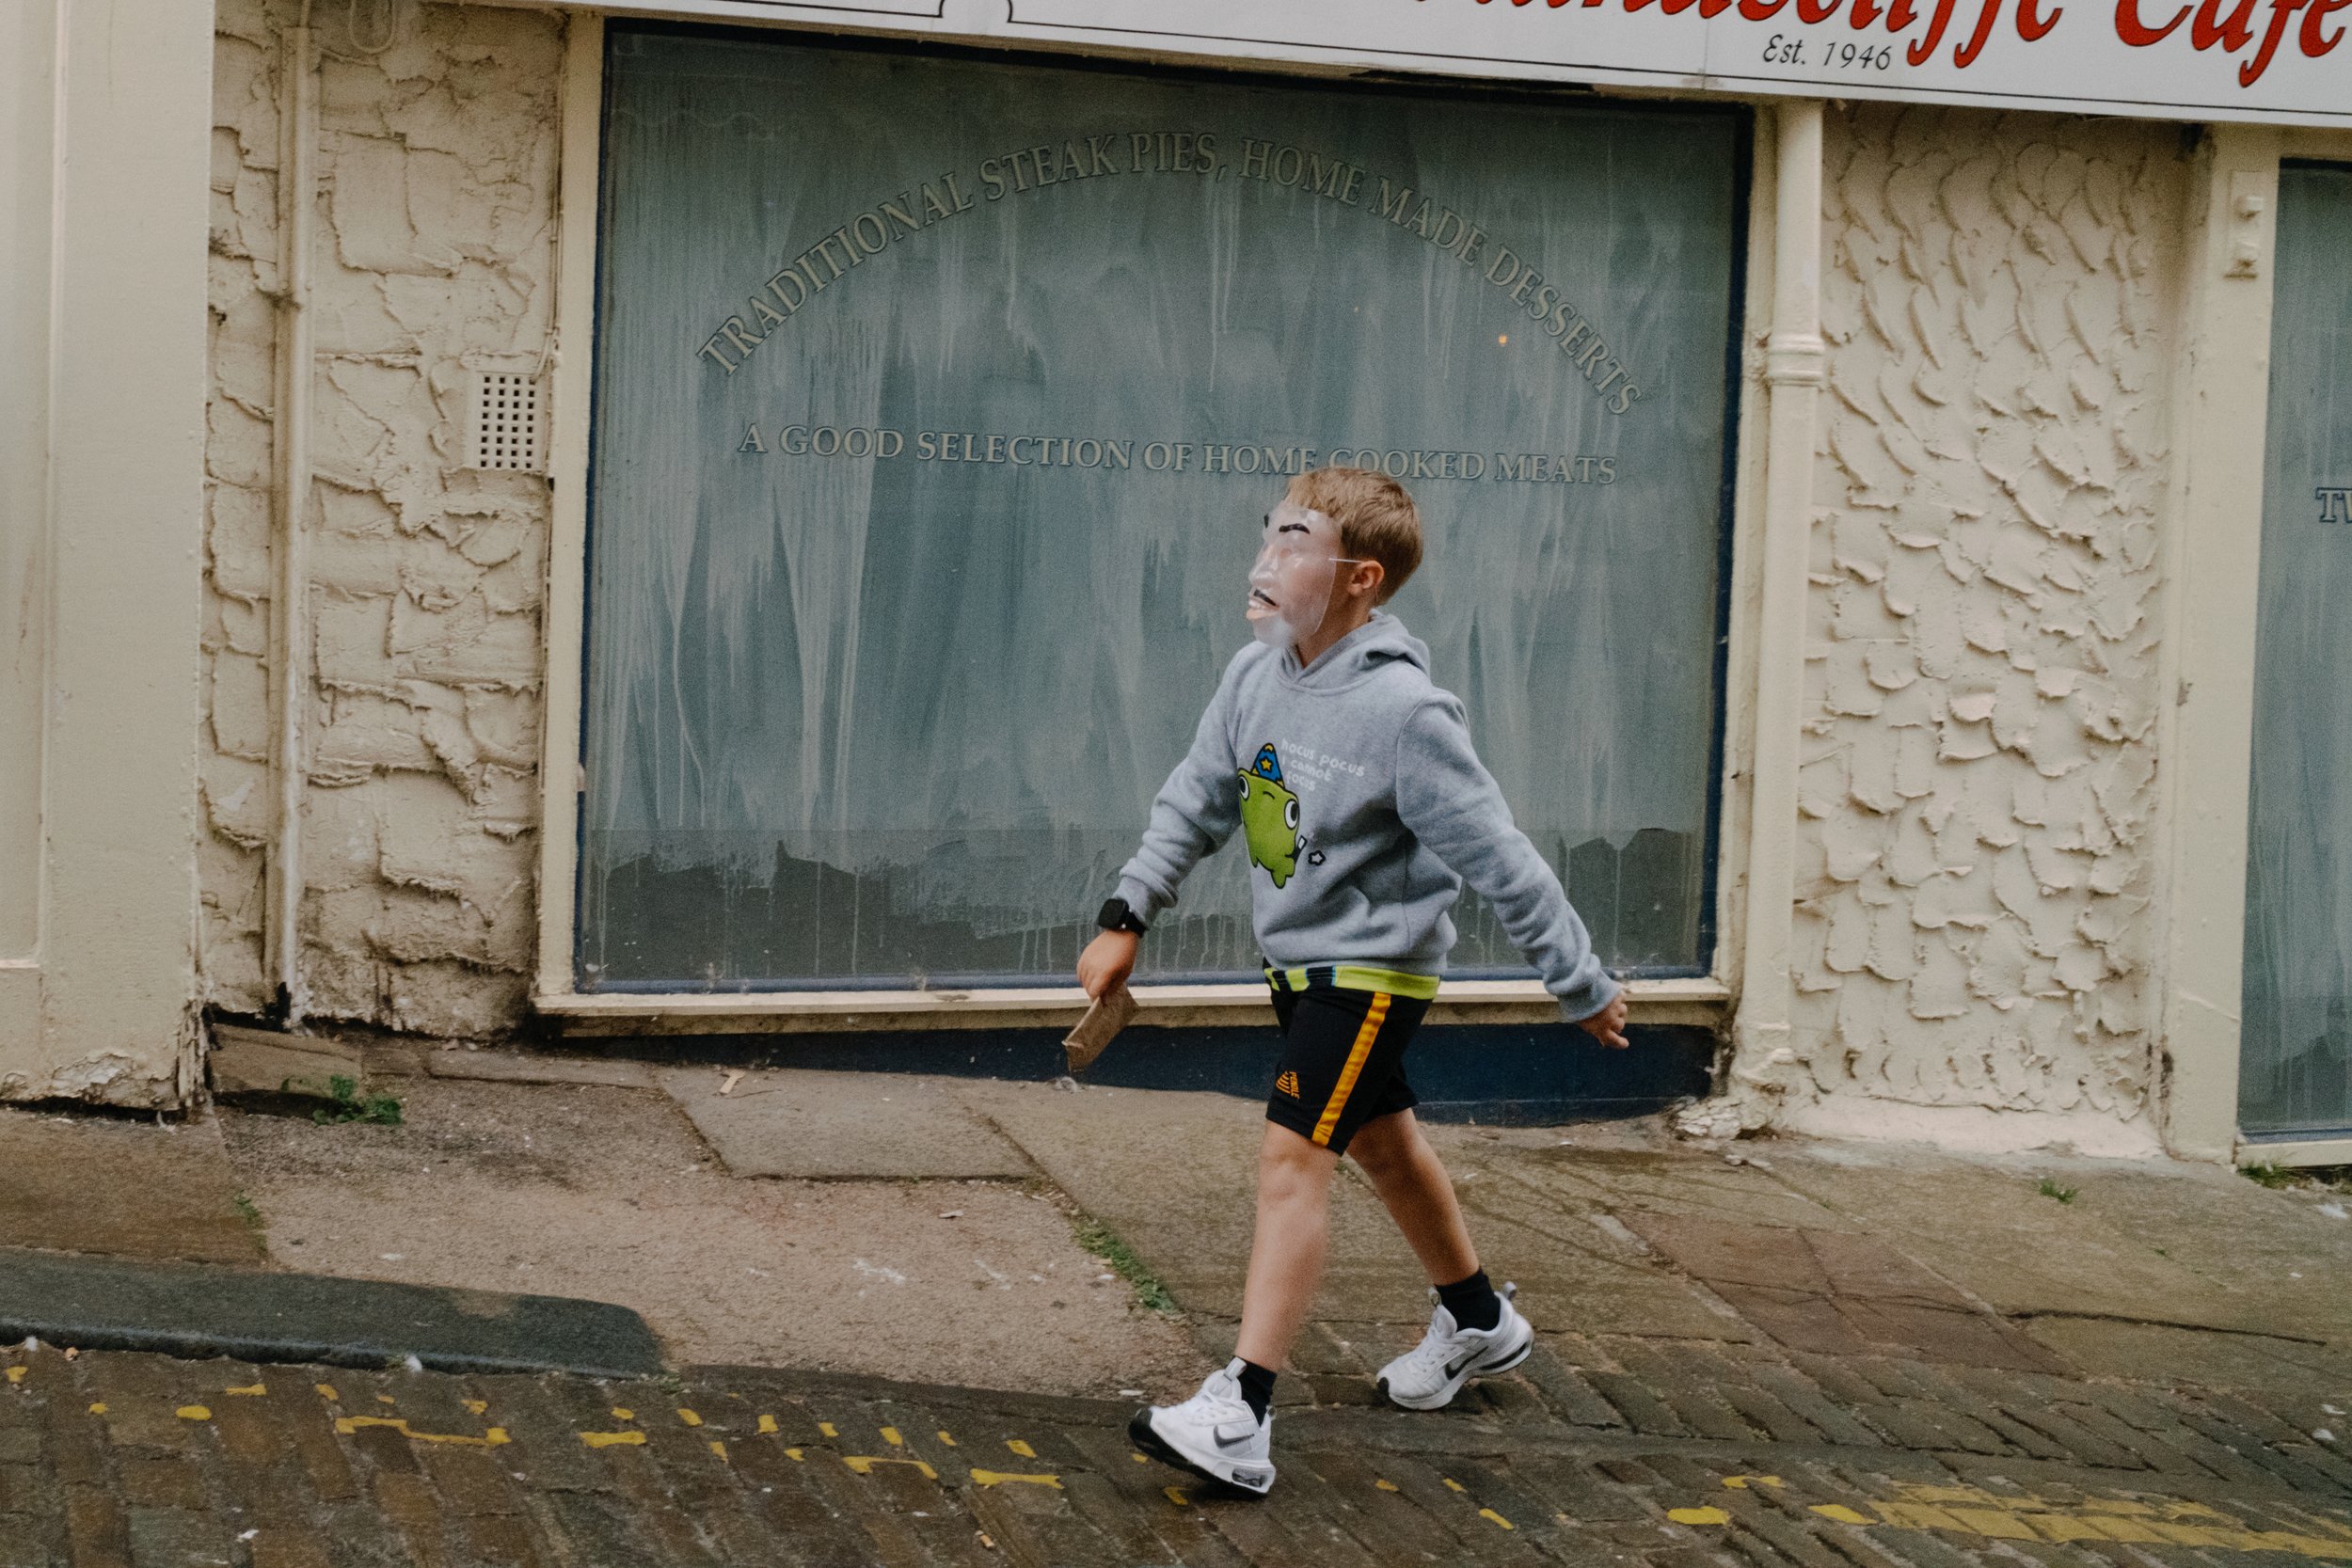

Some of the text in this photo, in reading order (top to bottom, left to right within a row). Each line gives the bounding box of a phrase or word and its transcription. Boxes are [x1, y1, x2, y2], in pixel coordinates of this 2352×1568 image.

[1763, 34, 1806, 65] Est.
[1822, 41, 1892, 71] 1946
[696, 131, 1643, 414] TRADITIONAL STEAK PIES, HOME MADE DESSERTS
[738, 423, 1616, 484] A GOOD SELECTION OF HOME COOKED MEATS
